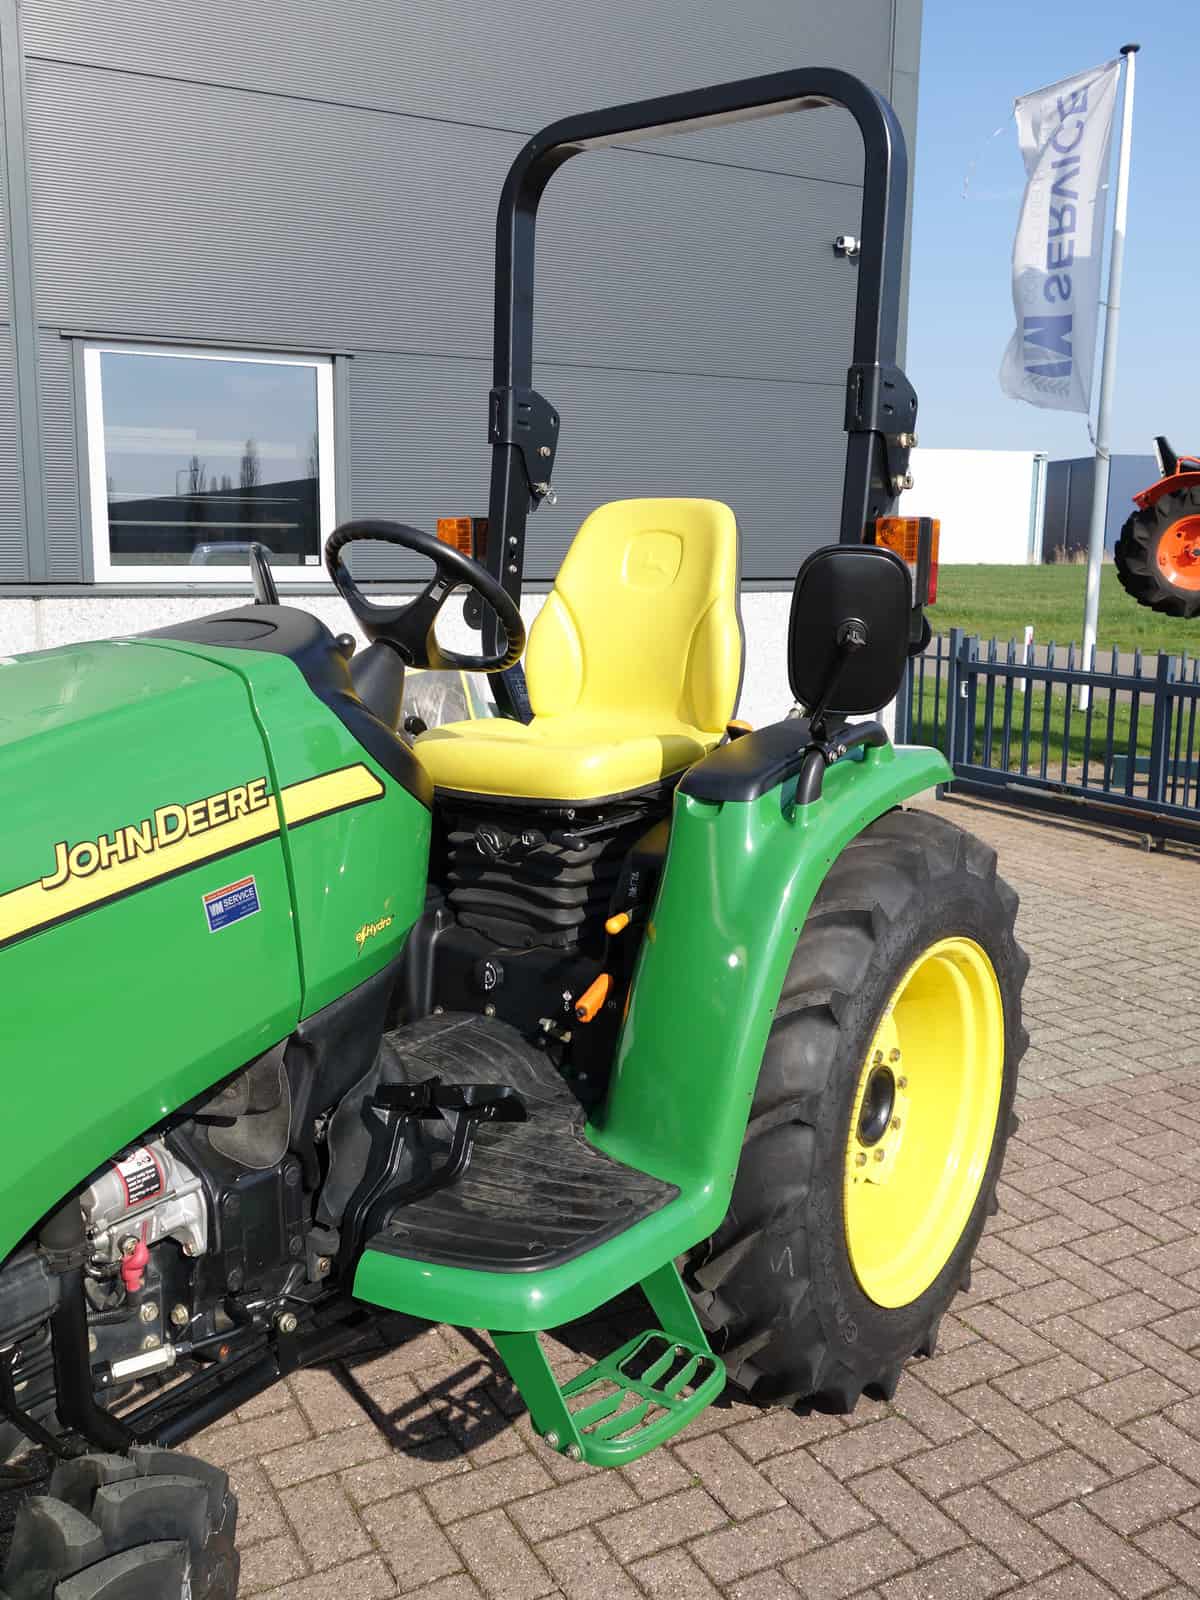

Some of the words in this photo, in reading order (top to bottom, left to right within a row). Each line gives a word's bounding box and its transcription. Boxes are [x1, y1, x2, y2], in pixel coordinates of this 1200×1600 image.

[41, 818, 154, 890] JOHN
[153, 776, 270, 849] DEERE
[223, 887, 255, 907] SERVICE
